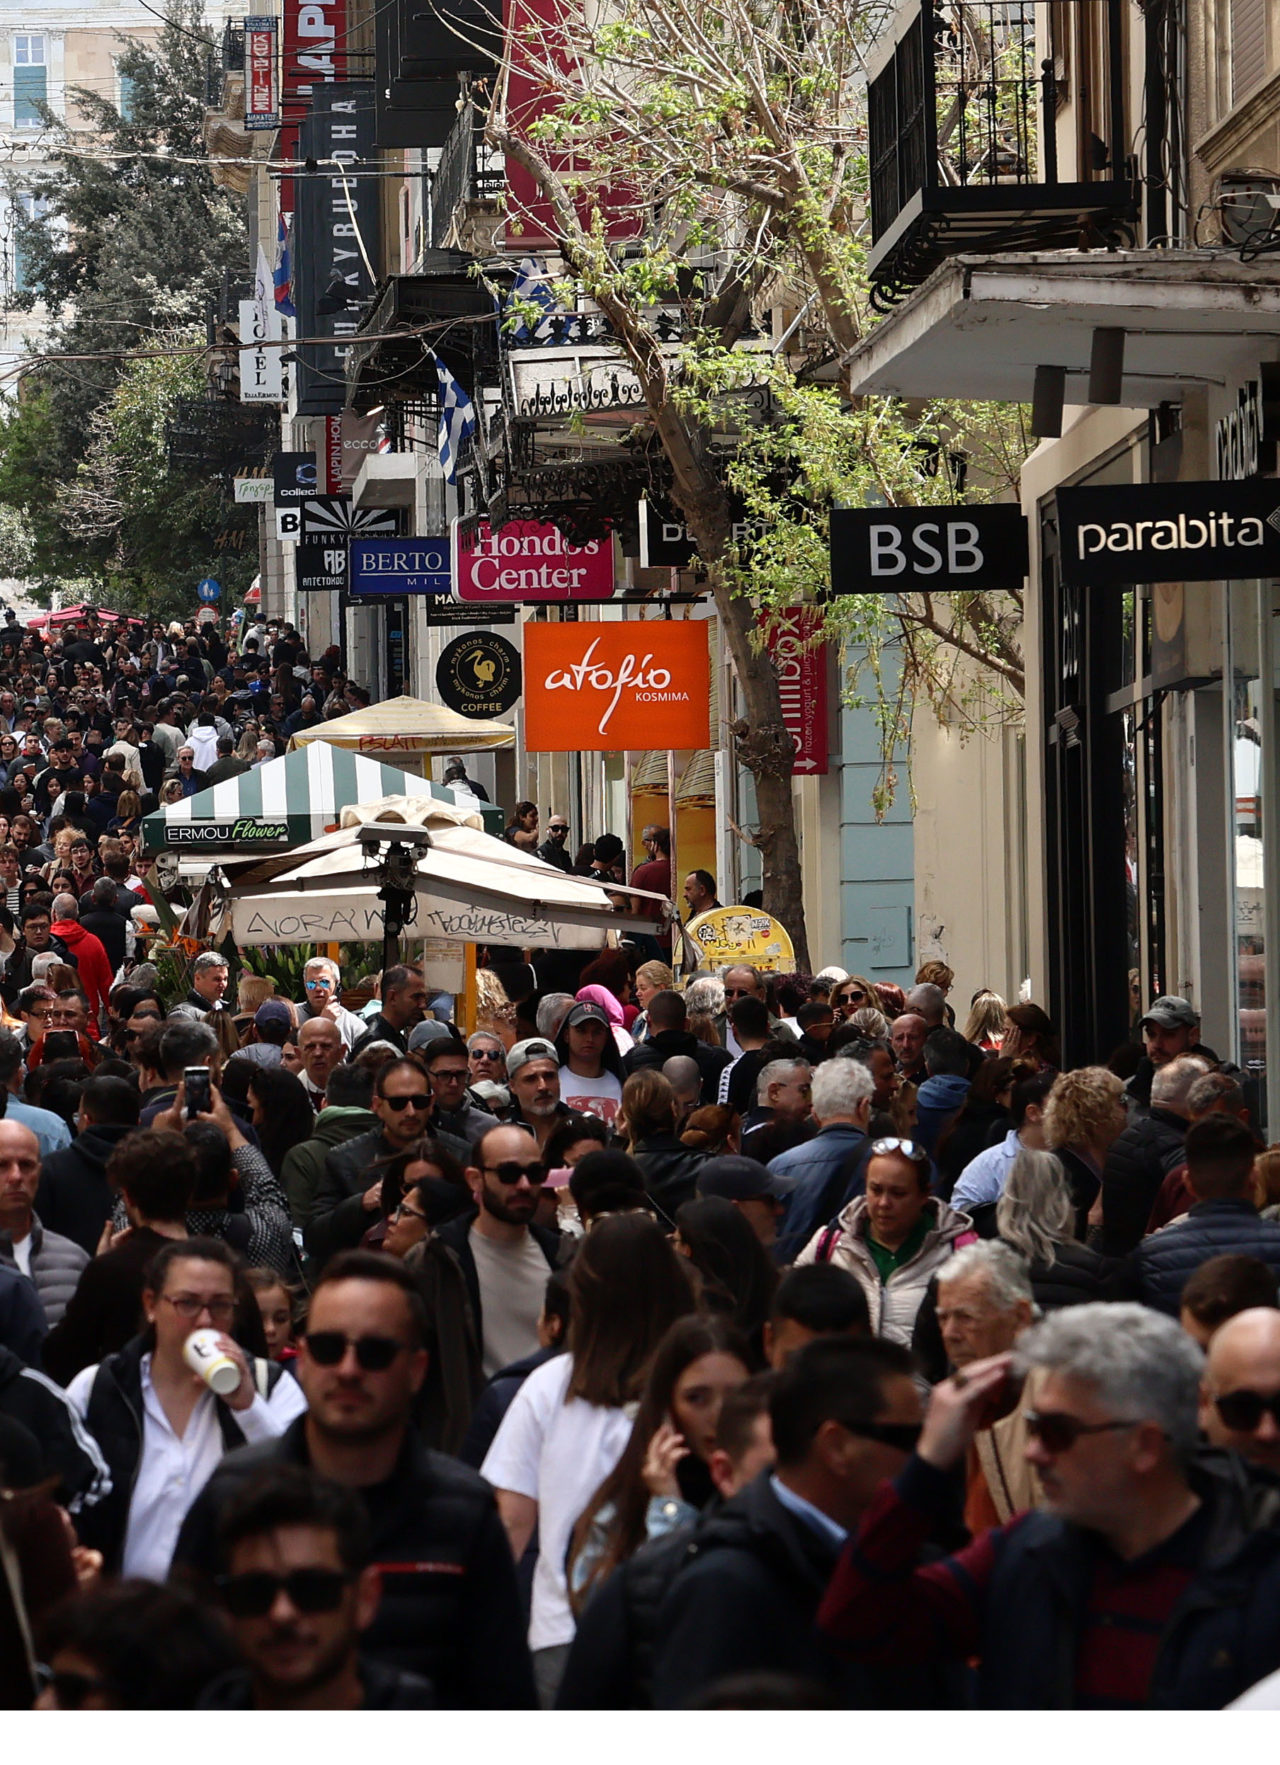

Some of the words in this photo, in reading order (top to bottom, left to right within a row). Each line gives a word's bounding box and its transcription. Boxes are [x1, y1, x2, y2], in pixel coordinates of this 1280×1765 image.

[343, 439, 378, 449] ecco
[1077, 510, 1265, 561] parabita
[869, 520, 985, 577] BSB
[361, 551, 443, 571] BERTO
[470, 556, 588, 591] Center
[450, 638, 484, 666] mykonos
[489, 640, 511, 665] charm
[451, 678, 485, 701] mykonos
[489, 676, 510, 698] charm
[635, 691, 690, 702] KOSMIMA
[461, 702, 503, 712] COFFEE
[167, 826, 230, 842] ERMOU
[232, 819, 288, 839] Flower
